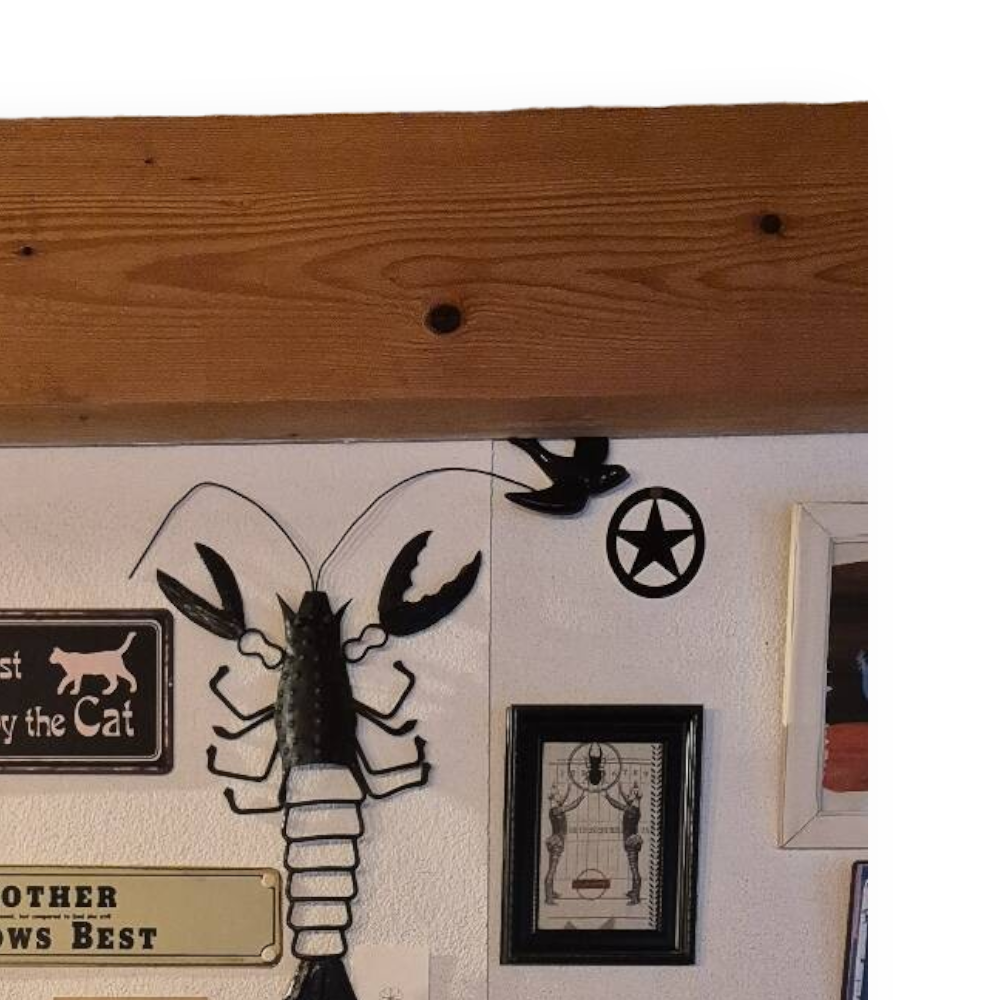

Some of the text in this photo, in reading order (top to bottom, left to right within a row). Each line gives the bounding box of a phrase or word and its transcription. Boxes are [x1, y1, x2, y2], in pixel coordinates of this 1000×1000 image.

[25, 706, 66, 737] the
[74, 695, 135, 738] Cat
[72, 921, 158, 951] BEST
